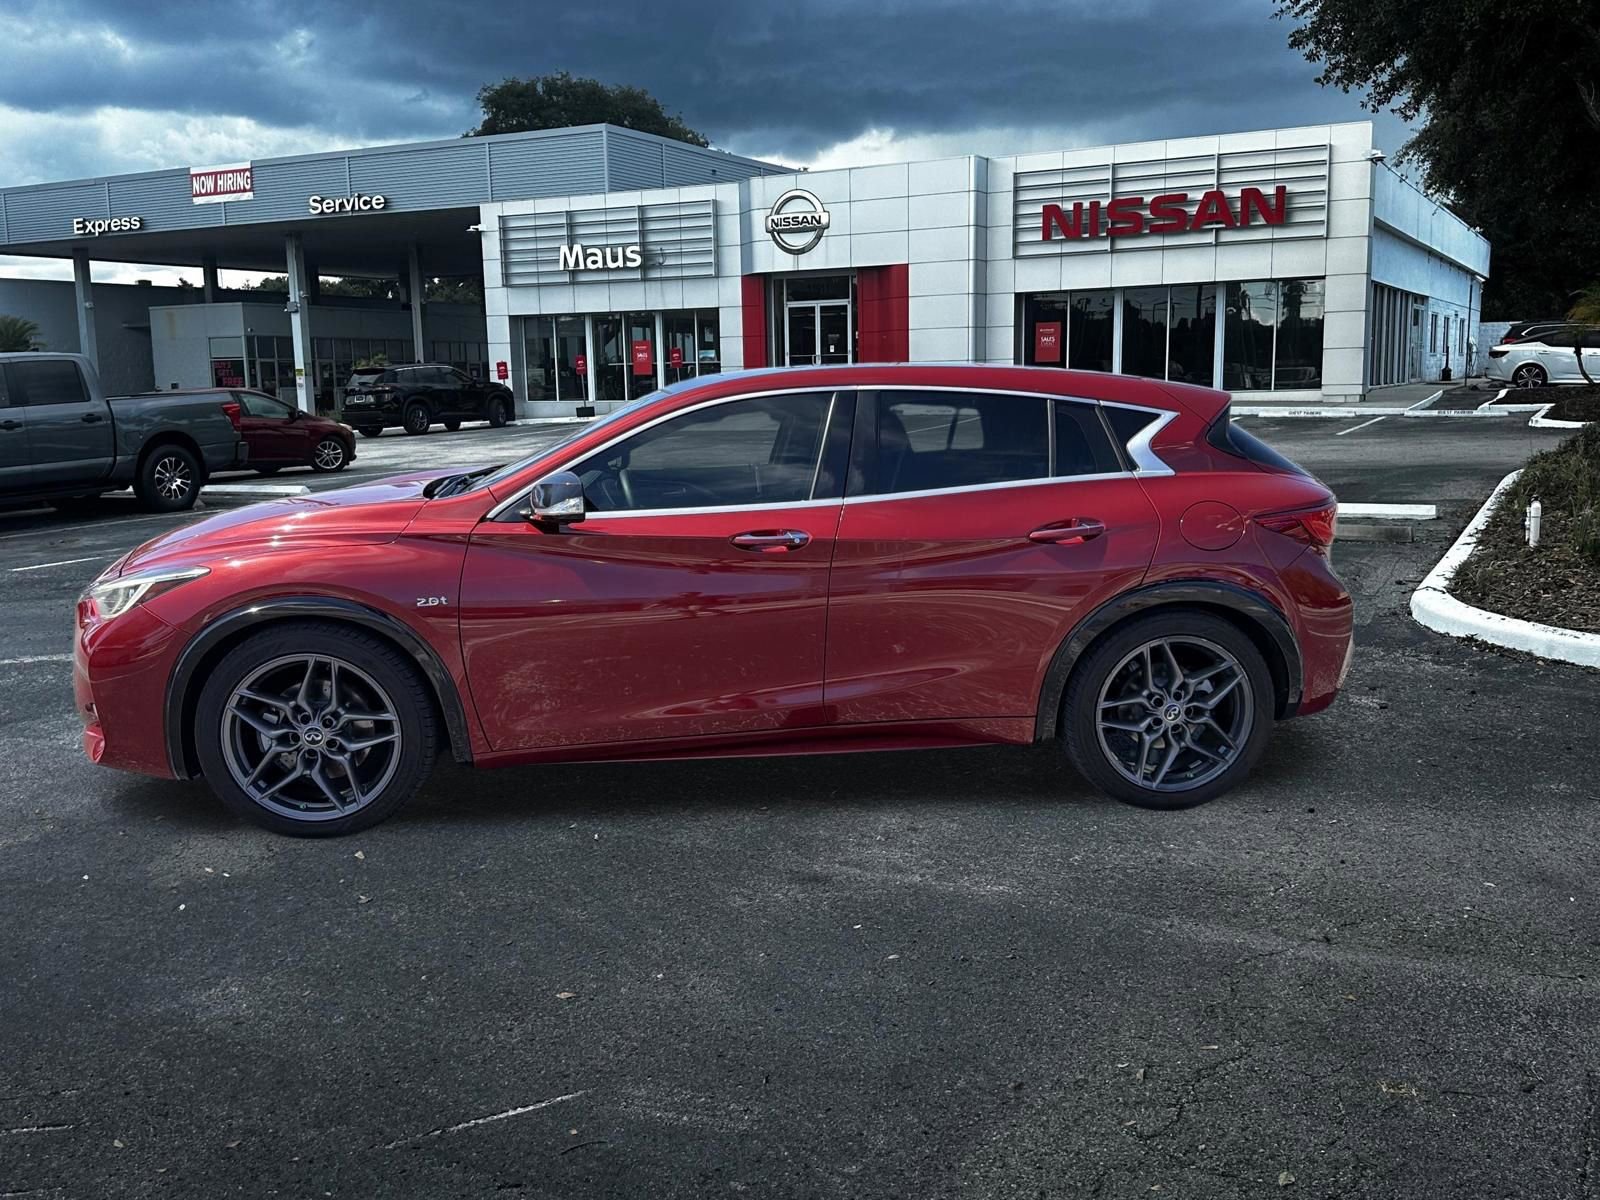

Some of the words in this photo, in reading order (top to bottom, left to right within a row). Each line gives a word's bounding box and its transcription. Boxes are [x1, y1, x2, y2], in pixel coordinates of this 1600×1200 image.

[192, 174, 215, 195] NOW
[217, 171, 251, 192] HIRING
[309, 193, 385, 214] Service
[1042, 185, 1287, 241] NISSAN
[73, 216, 141, 236] Express
[770, 215, 822, 228] NISSAN
[560, 243, 642, 271] Maus
